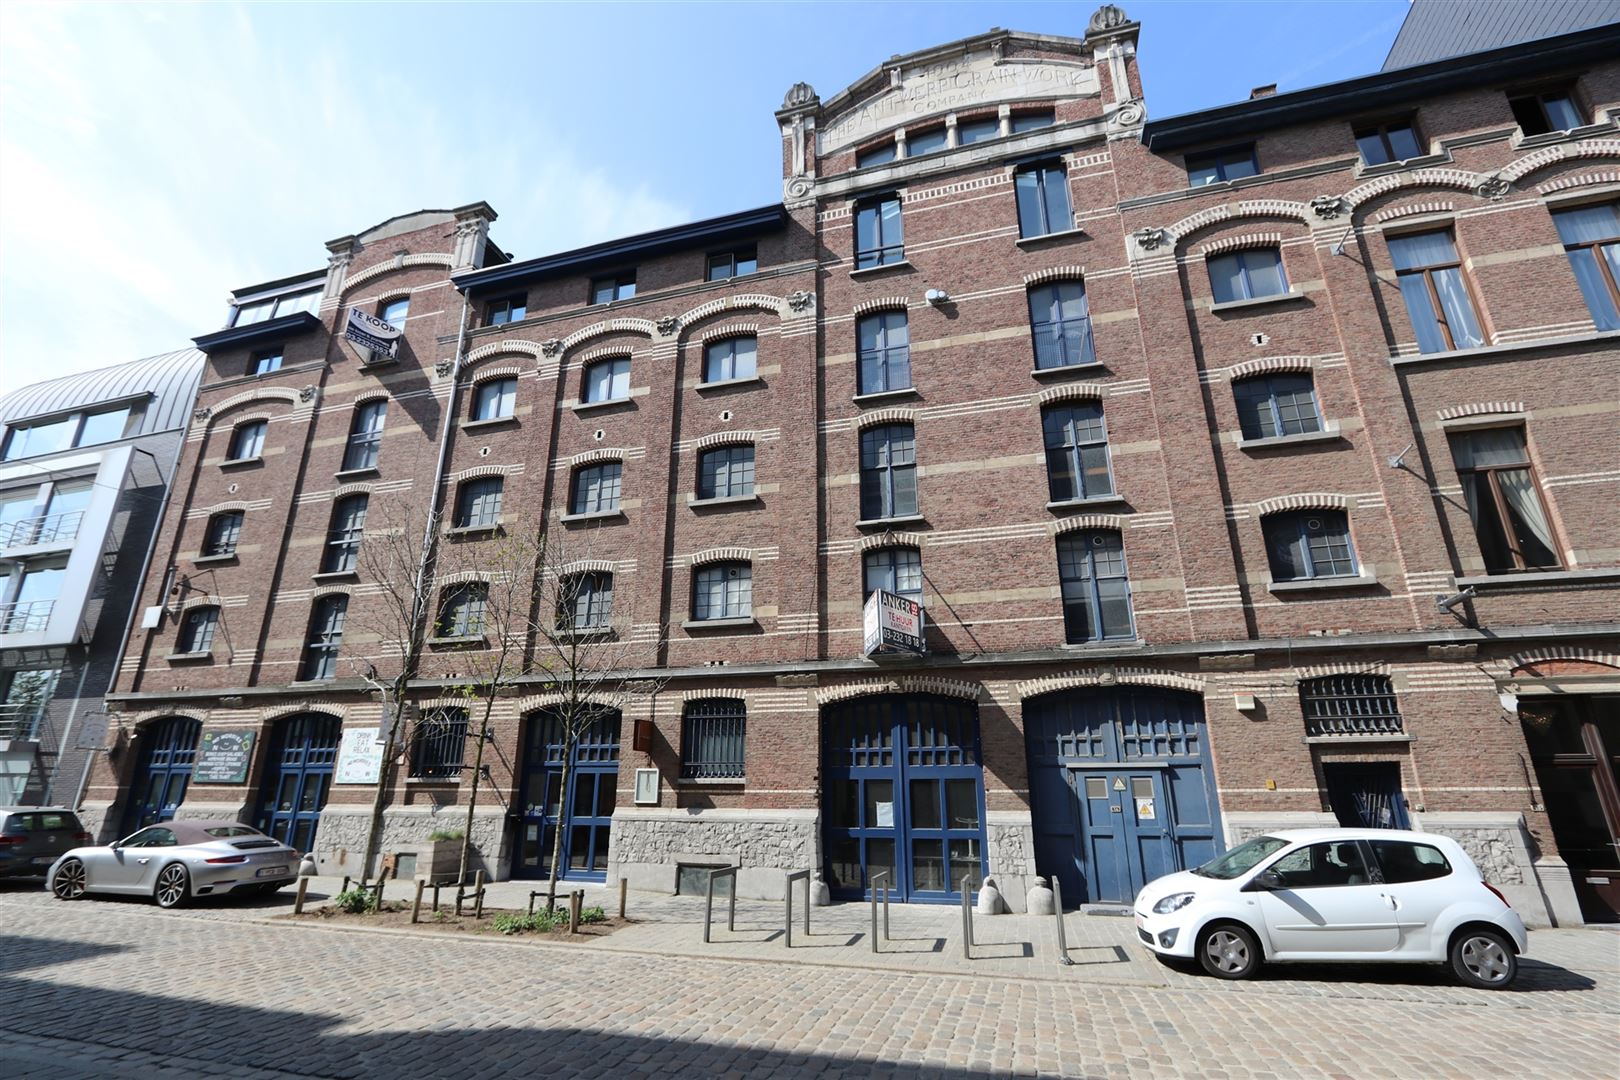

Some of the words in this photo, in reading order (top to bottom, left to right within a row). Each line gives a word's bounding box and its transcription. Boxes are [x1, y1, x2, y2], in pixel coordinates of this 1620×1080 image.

[825, 117, 855, 144] THE
[860, 78, 948, 127] ANTWERP
[955, 65, 1017, 89] GRAIN
[913, 88, 988, 114] COMPANY
[352, 308, 363, 320] TE
[365, 315, 396, 334] KOOP
[882, 593, 911, 614] ANKER
[888, 611, 896, 622] TE
[896, 616, 913, 627] HUUR
[883, 629, 904, 643] 03-232
[905, 635, 912, 646] 18
[912, 637, 920, 648] 18
